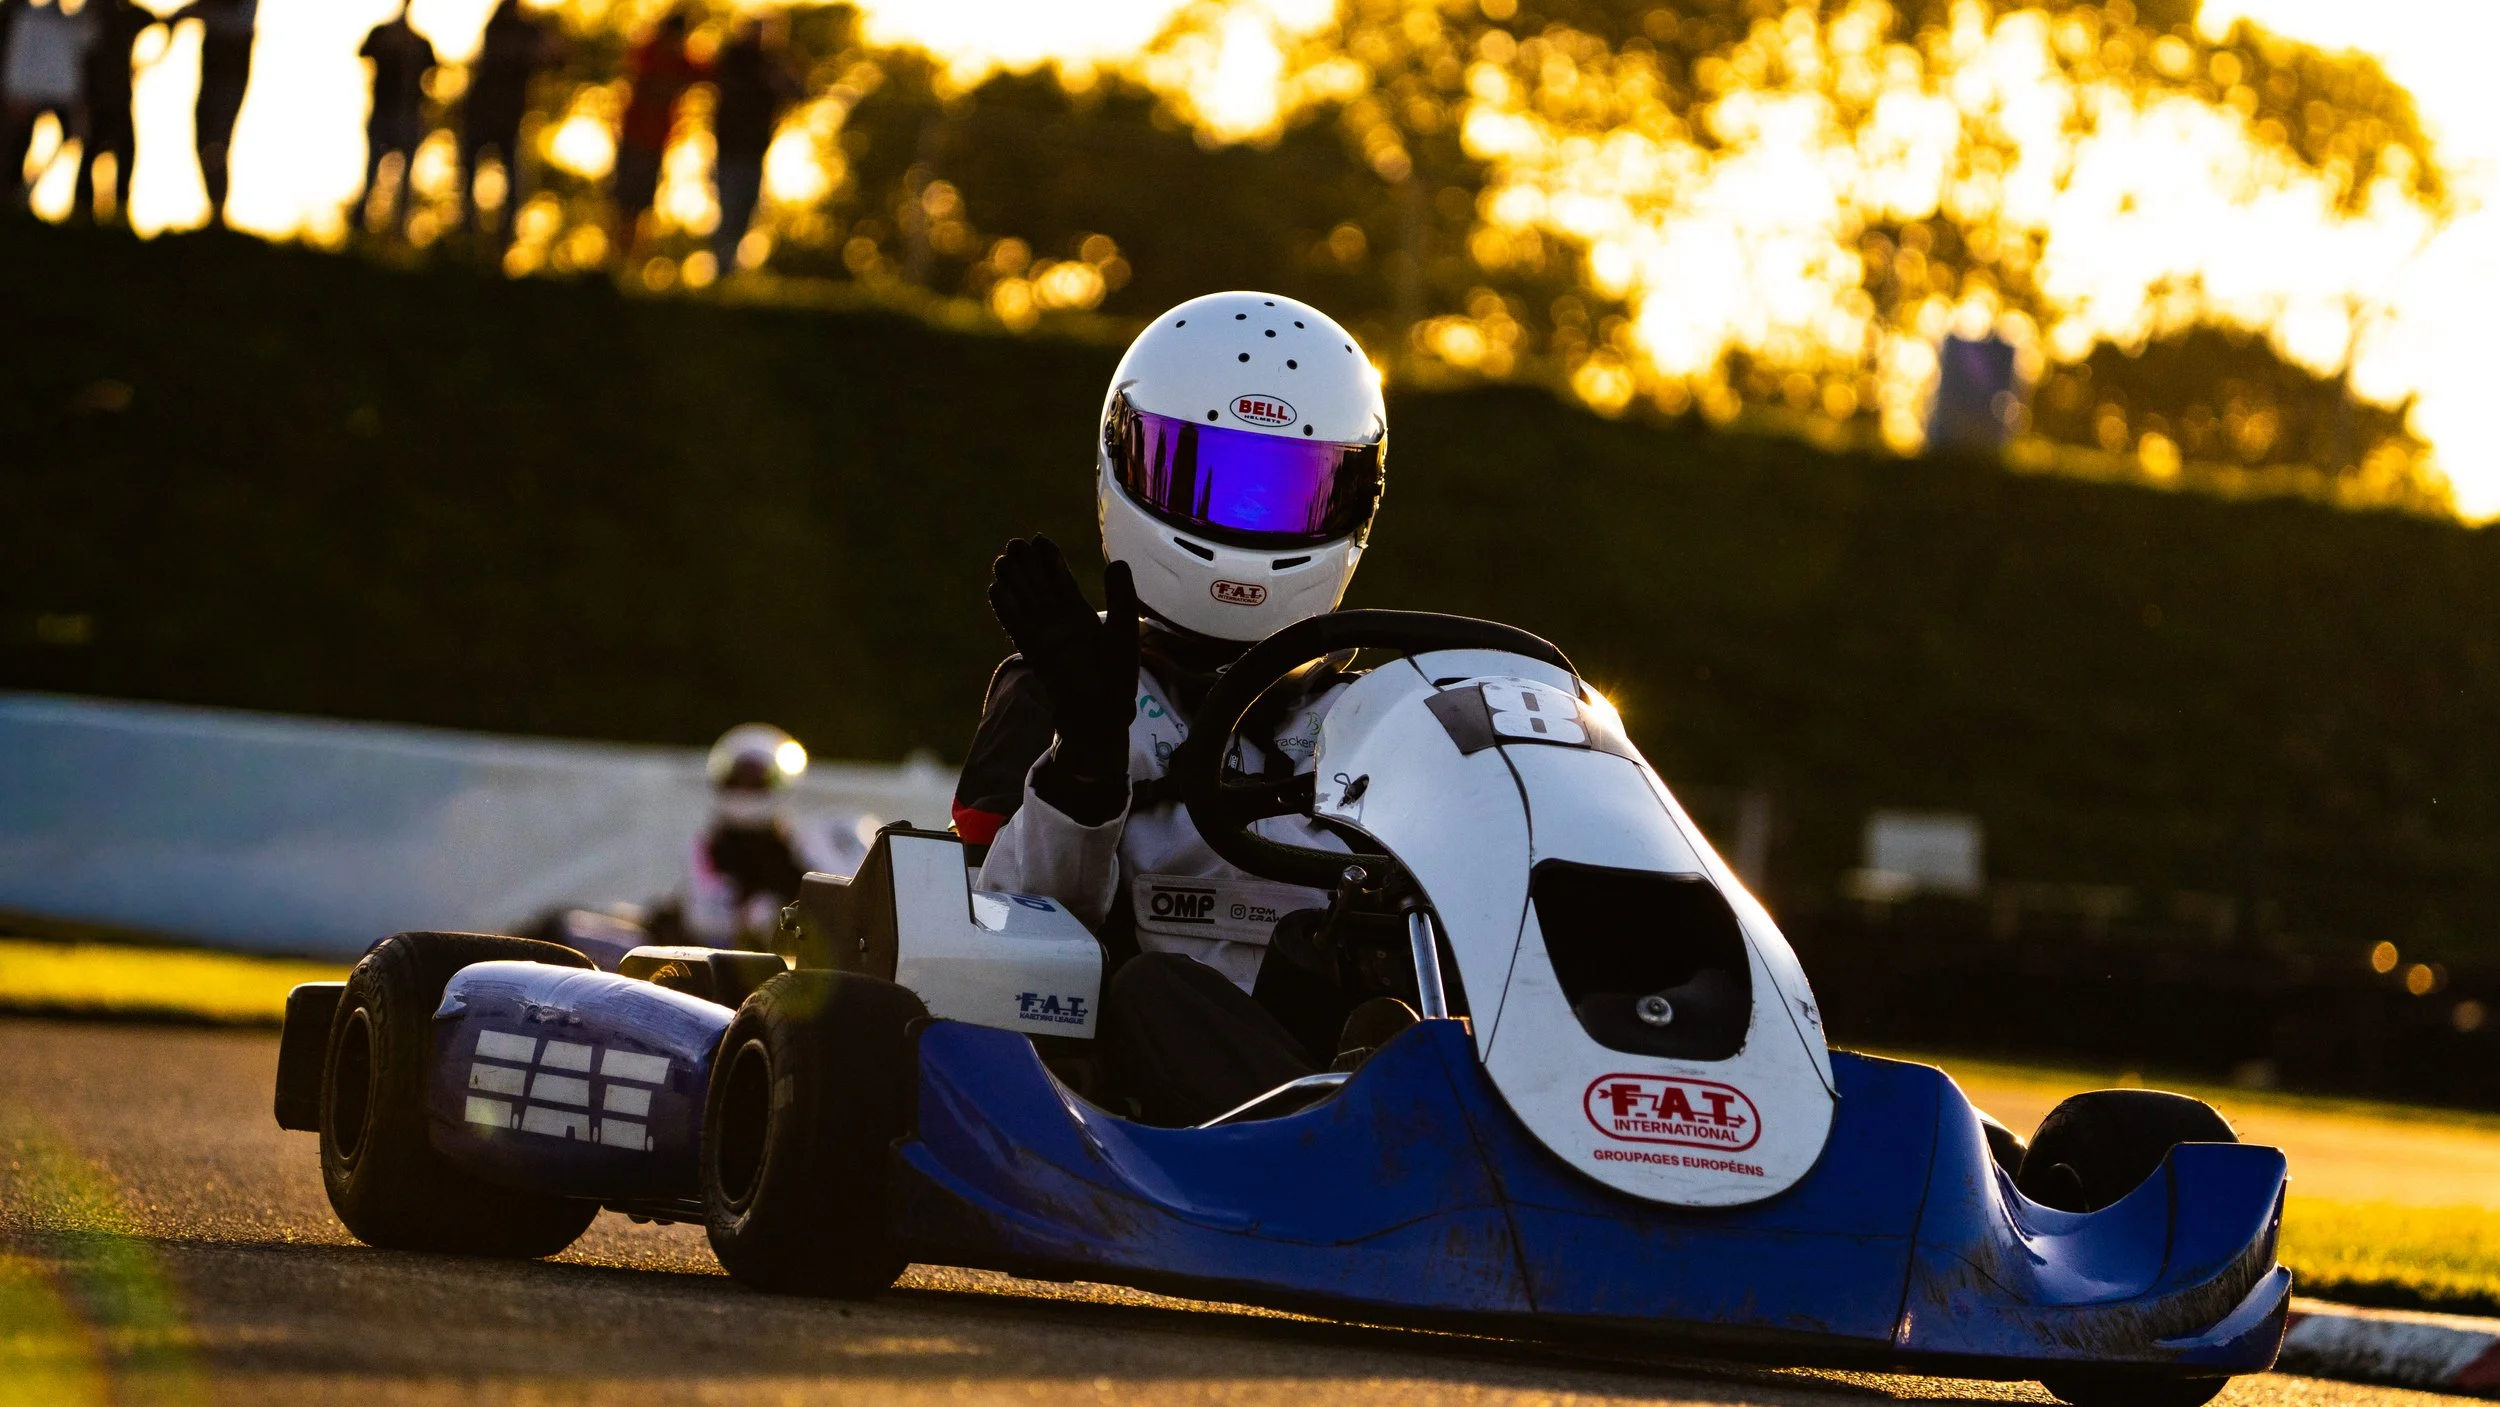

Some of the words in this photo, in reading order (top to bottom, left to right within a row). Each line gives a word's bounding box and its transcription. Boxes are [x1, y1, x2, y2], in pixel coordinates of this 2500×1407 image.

[1239, 400, 1287, 420] BELL
[1482, 681, 1586, 744] 8
[1151, 893, 1214, 917] OMP
[1250, 907, 1275, 915] TOM
[1019, 1012, 1053, 1022] KARTING
[1054, 1016, 1084, 1025] LEAGUE
[1614, 1119, 1740, 1143] INTERNATIONAL
[1594, 1149, 1679, 1166] GROUPAGES
[1683, 1156, 1764, 1177] EUROPÉENS
